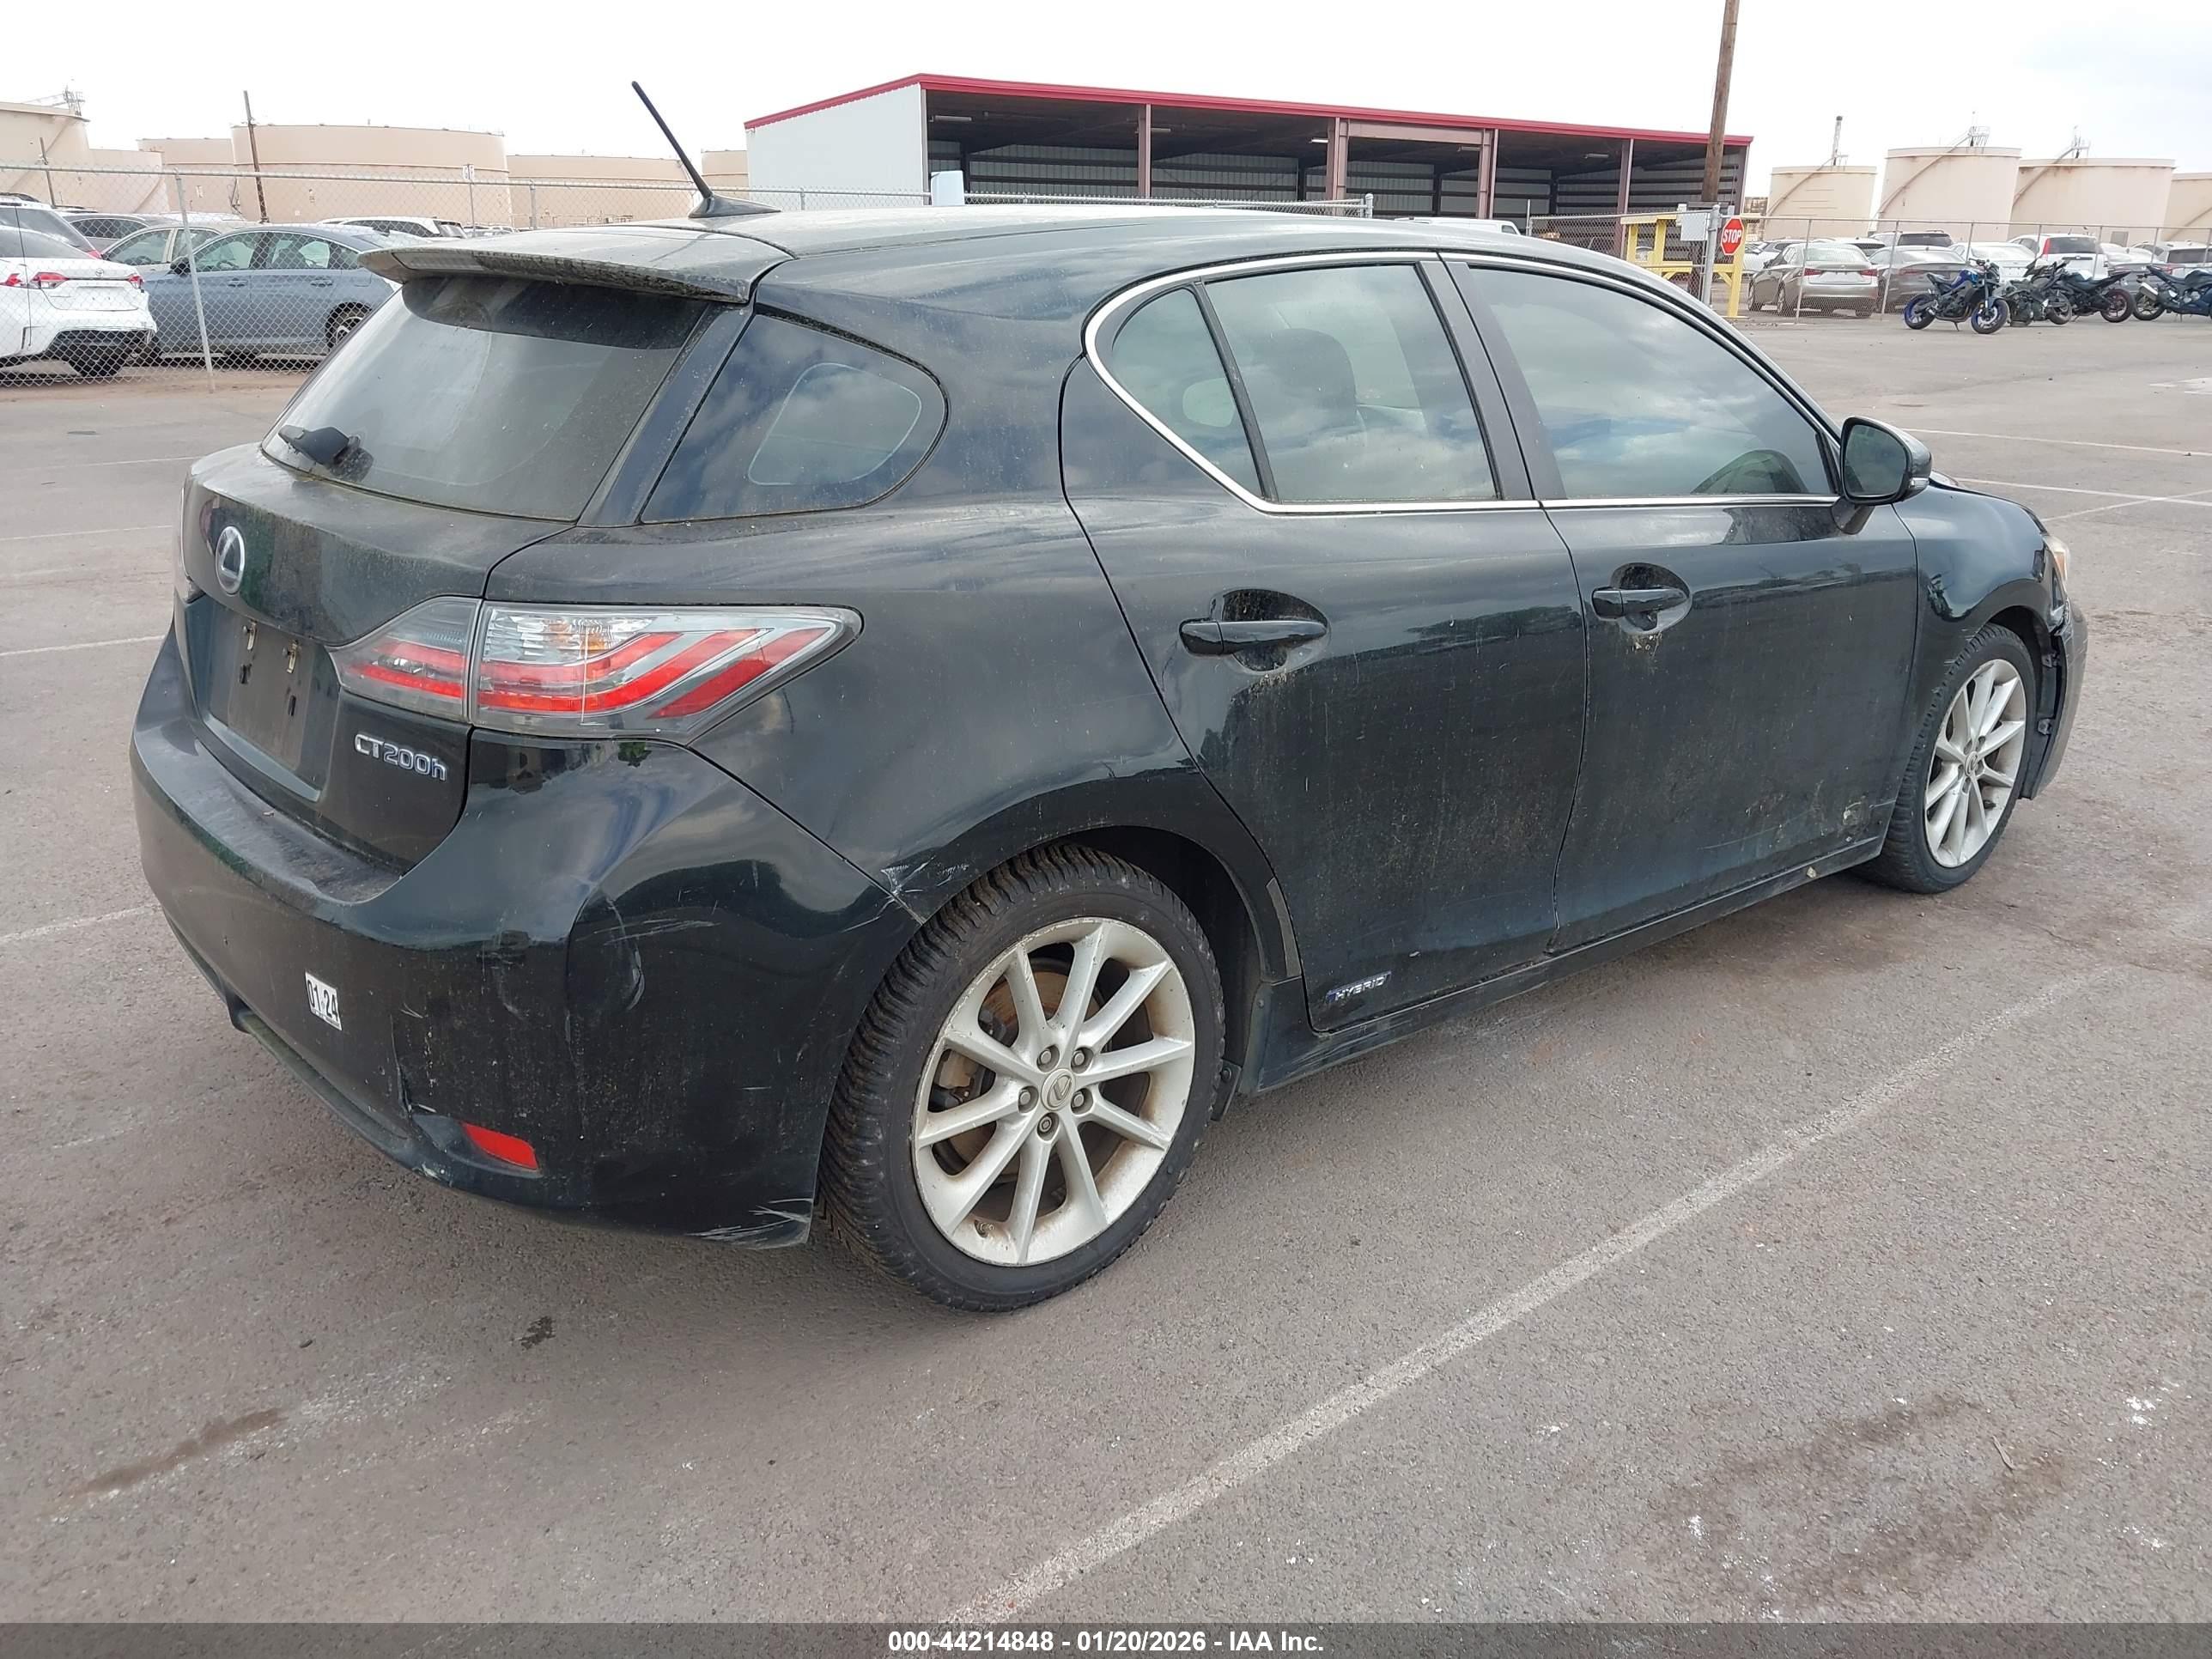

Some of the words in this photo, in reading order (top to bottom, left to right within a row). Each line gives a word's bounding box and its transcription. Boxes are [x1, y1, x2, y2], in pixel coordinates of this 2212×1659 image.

[1723, 228, 1742, 244] STOP
[355, 732, 447, 781] CT200h
[1334, 976, 1385, 1001] HYBRID
